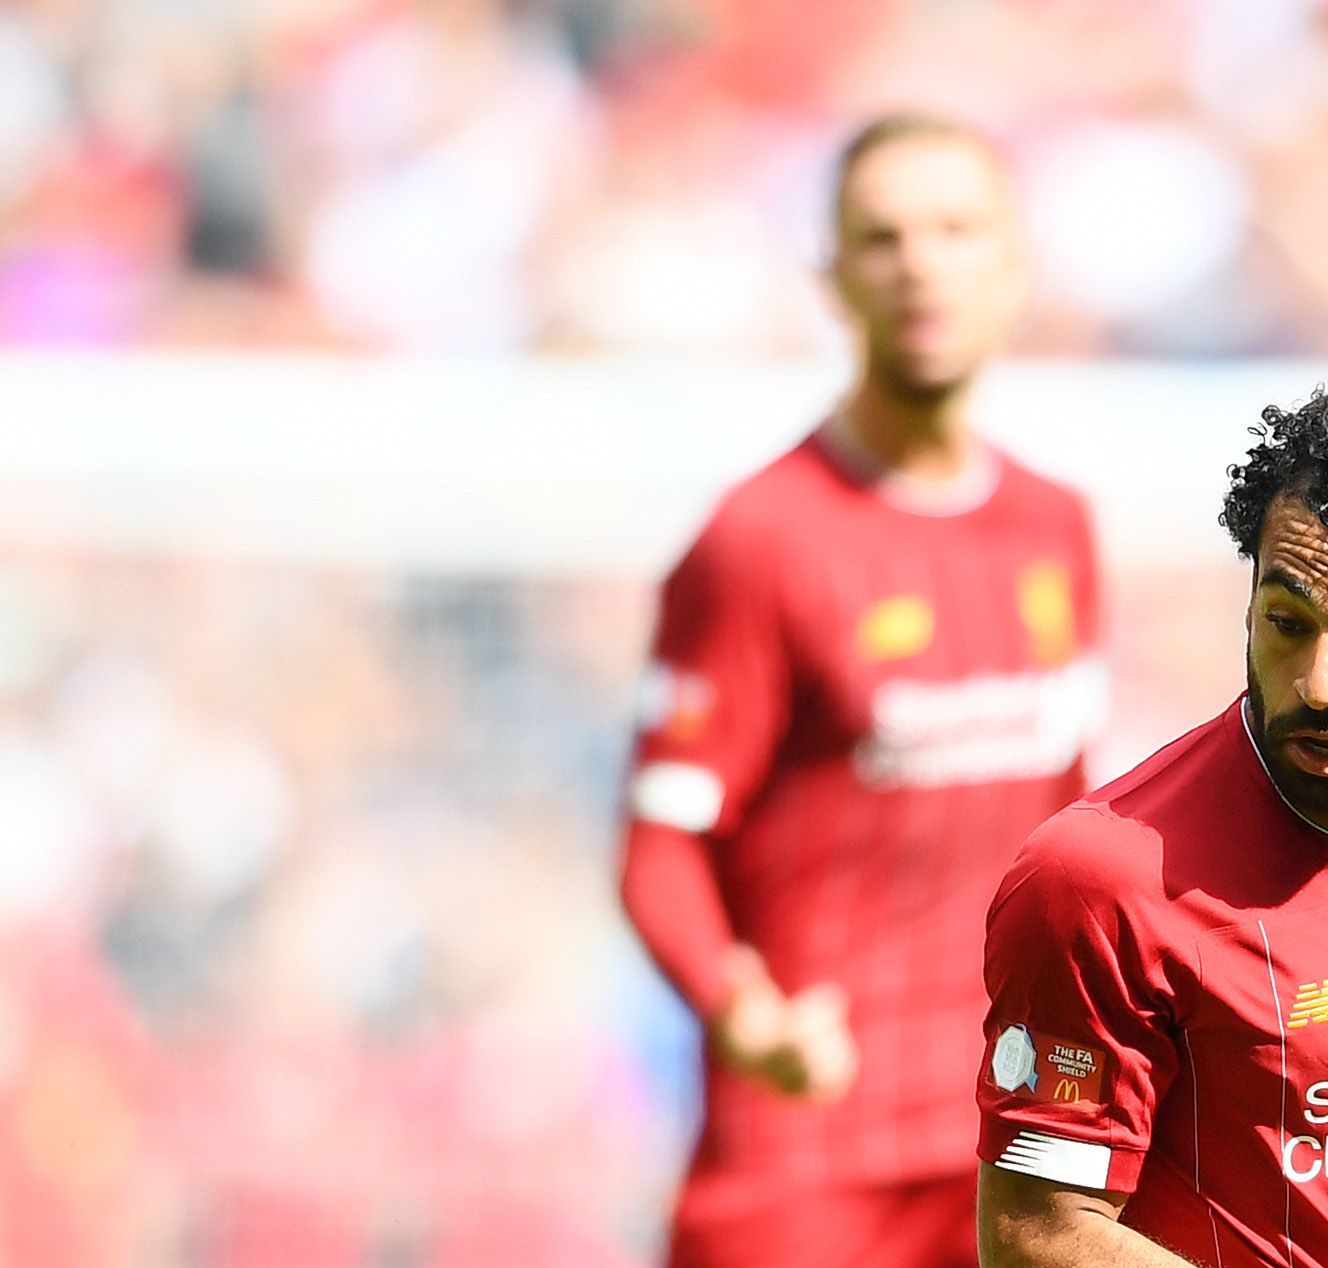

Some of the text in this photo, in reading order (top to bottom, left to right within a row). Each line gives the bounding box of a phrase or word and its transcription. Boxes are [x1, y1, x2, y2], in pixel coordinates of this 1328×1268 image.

[1048, 1053, 1097, 1073] COMMUNITY
[1055, 1044, 1094, 1065] THE FA
[1057, 1064, 1087, 1079] SHIELD
